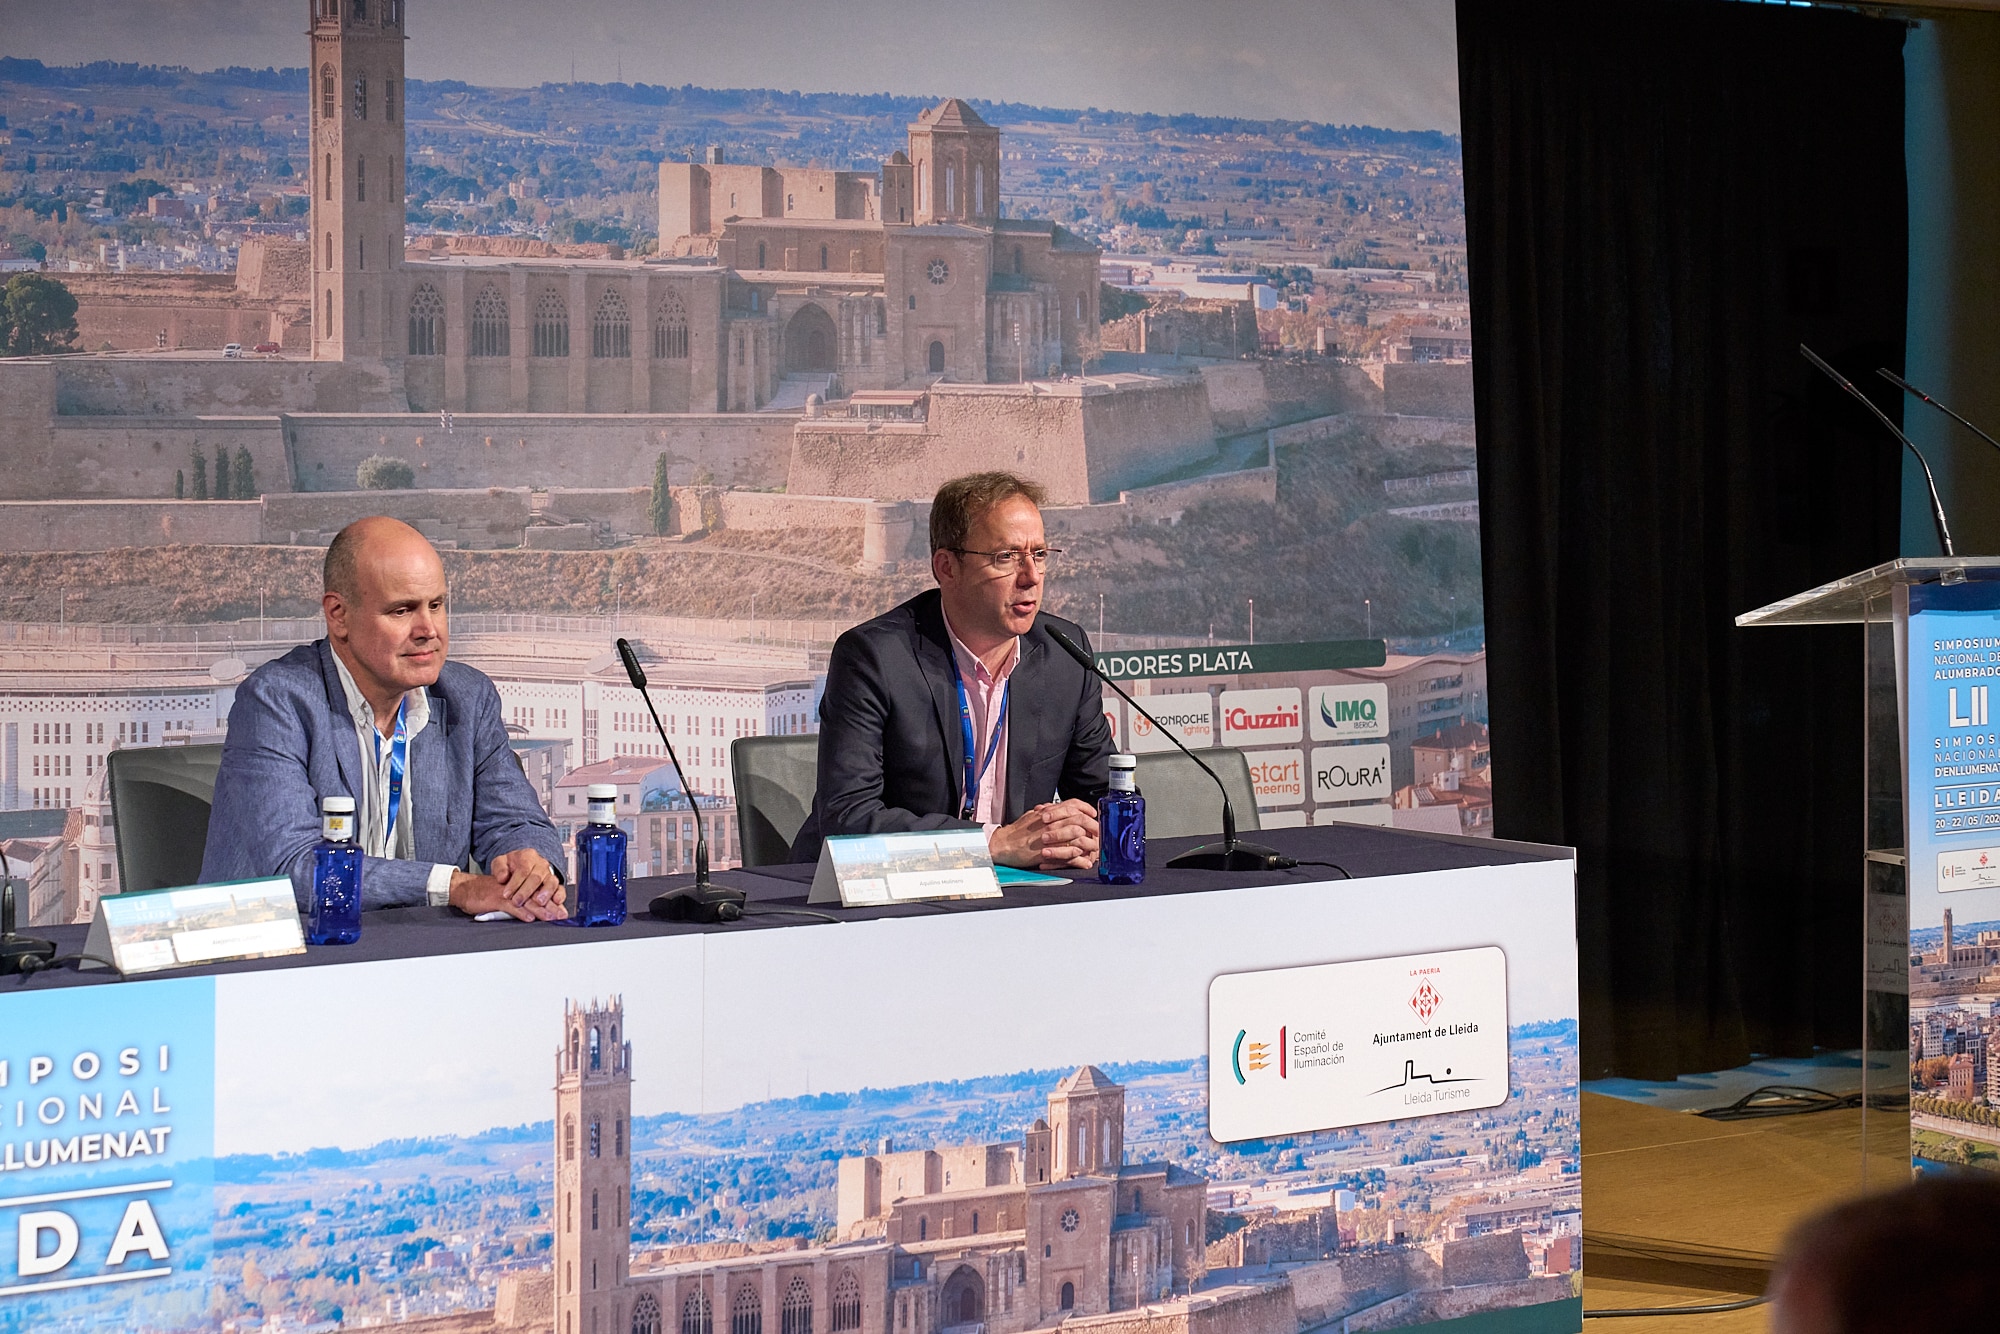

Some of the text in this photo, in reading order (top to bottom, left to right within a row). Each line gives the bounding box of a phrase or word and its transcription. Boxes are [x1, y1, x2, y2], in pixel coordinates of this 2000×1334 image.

[1189, 651, 1254, 673] PLATA
[1934, 653, 1986, 665] NACIONAL
[1335, 699, 1377, 722] IMQ
[1948, 685, 1988, 728] LII
[1154, 713, 1210, 727] FONROCHE
[1225, 704, 1299, 732] iGuzzini
[1353, 721, 1378, 729] IBERICA
[1183, 725, 1210, 737] lighting
[1419, 967, 1441, 976] PAERIA
[1293, 1029, 1327, 1043] Comité
[1372, 1022, 1479, 1046] Ajuntament de Lleida
[1294, 1041, 1344, 1057] Español de
[1294, 1054, 1345, 1069] Iluminación
[1404, 1088, 1471, 1105] Lleida Turisme
[0, 1087, 171, 1128] IONAL
[0, 1127, 172, 1172] LUMENAT
[18, 1199, 171, 1277] DA
